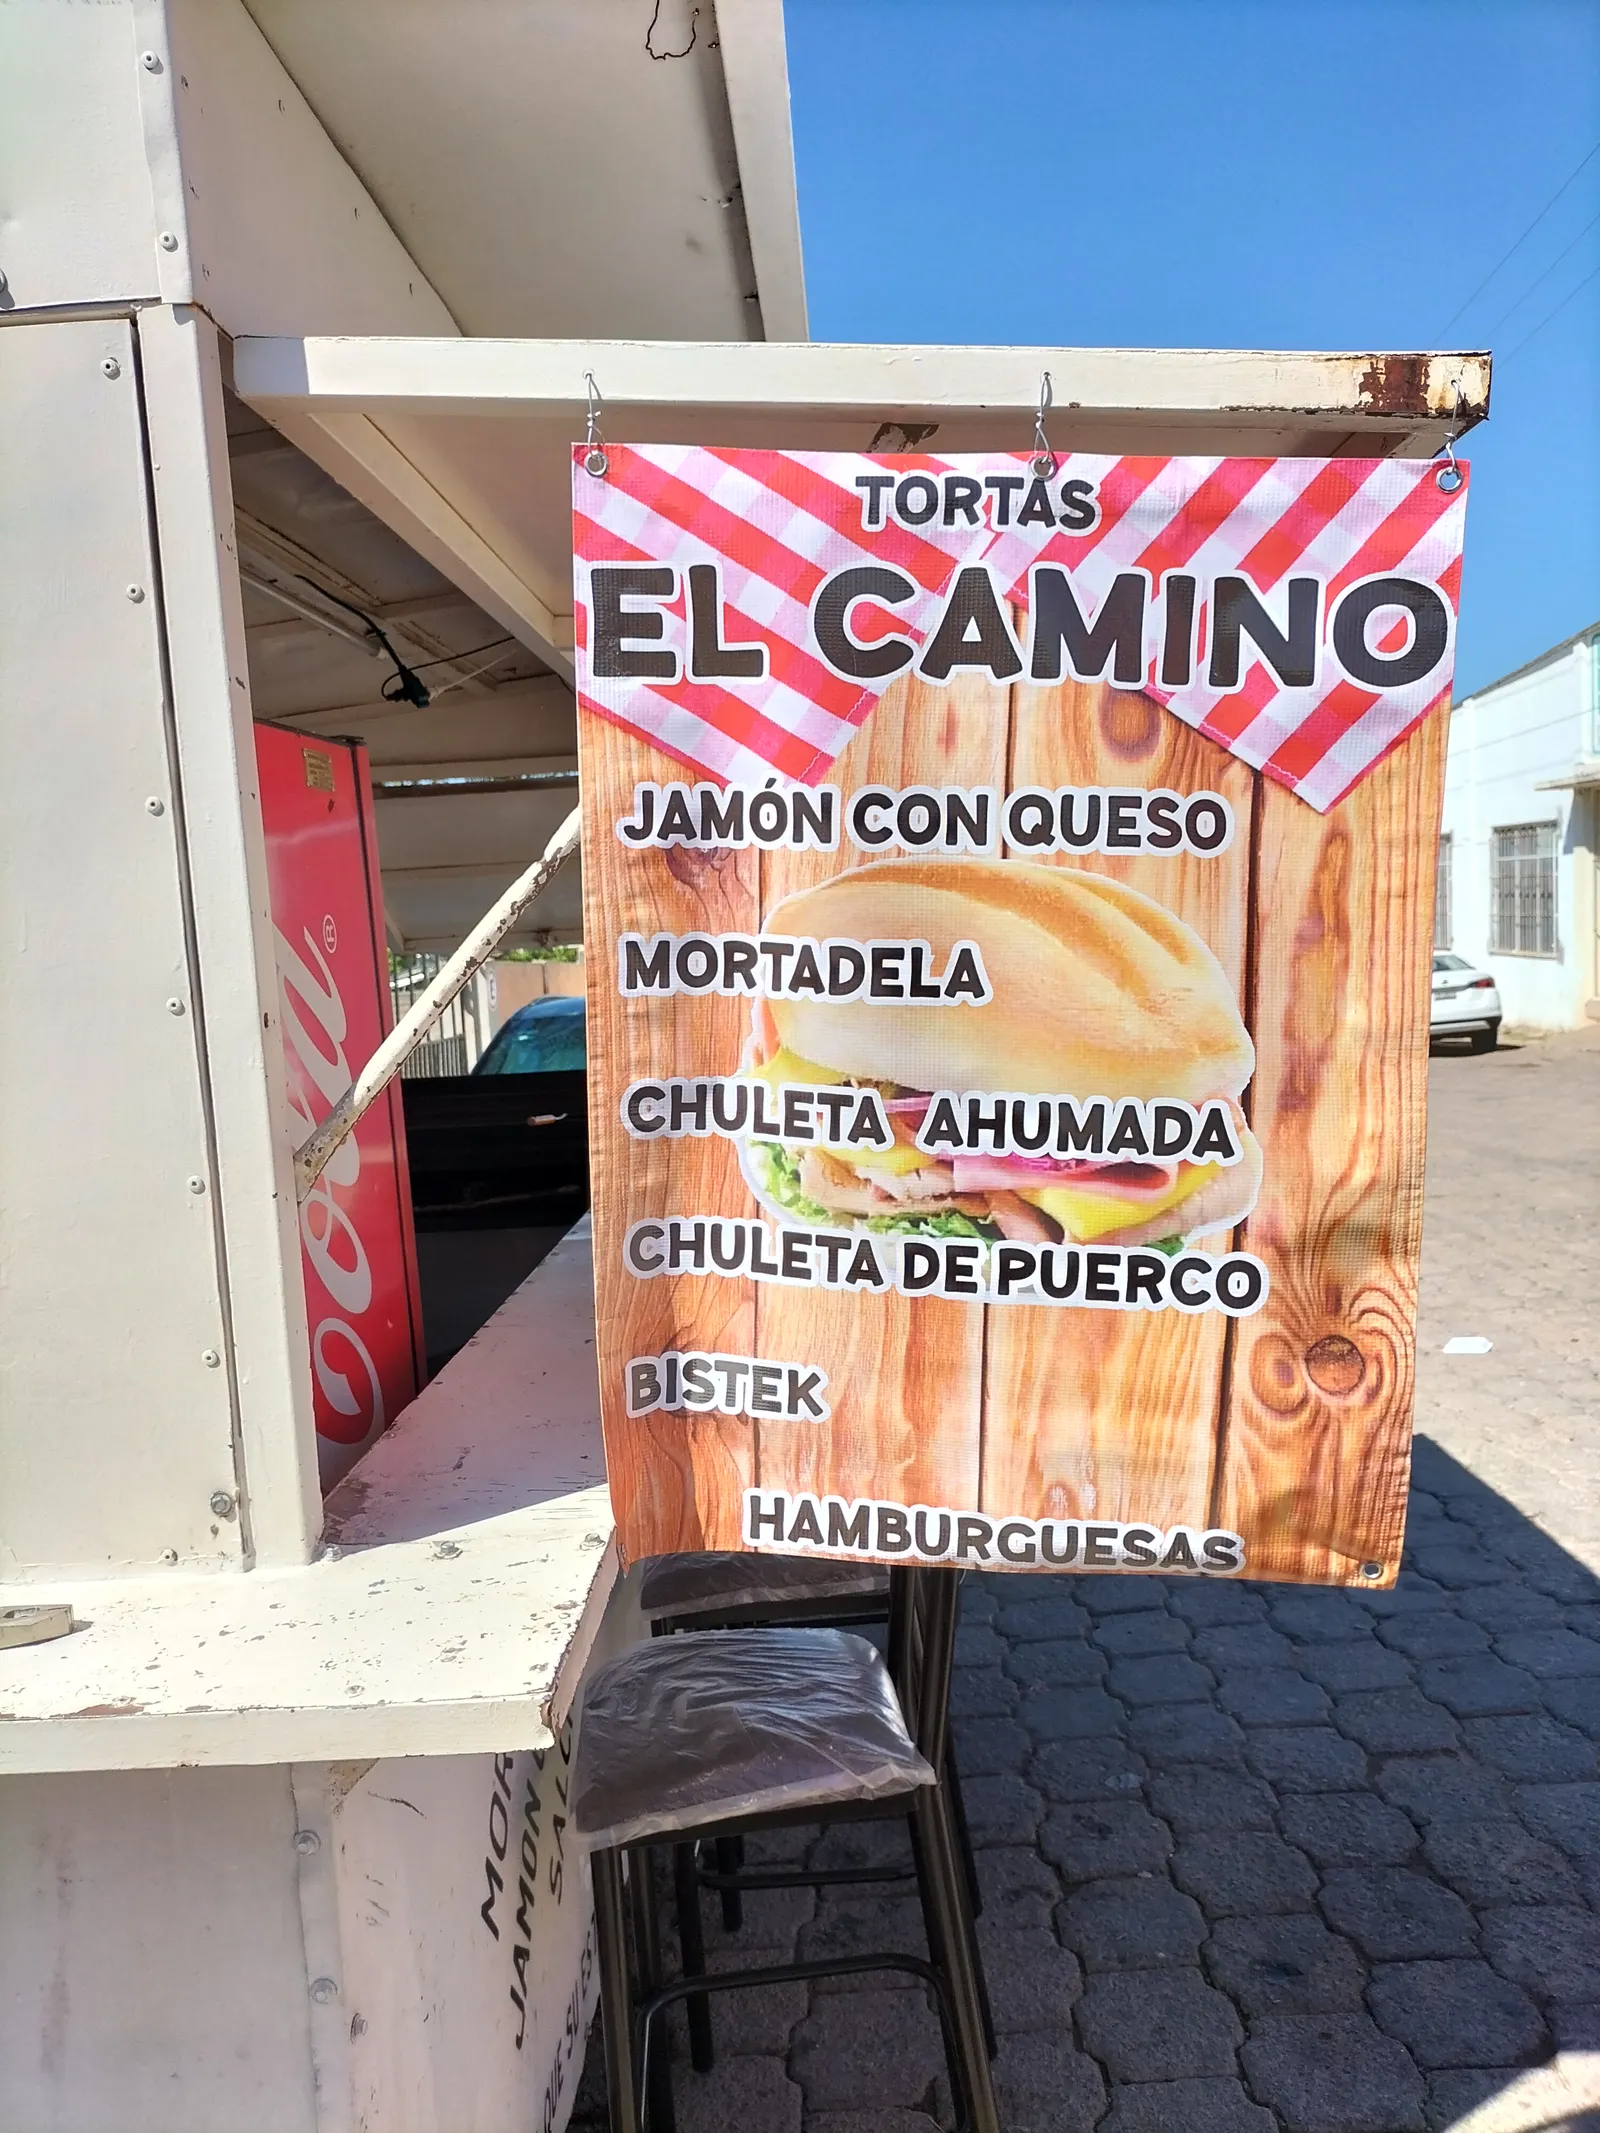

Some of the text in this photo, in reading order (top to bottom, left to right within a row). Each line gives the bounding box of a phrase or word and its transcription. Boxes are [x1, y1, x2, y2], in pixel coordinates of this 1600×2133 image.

[855, 475, 1096, 530] TORTAS
[590, 564, 1448, 688] EL CAMINO
[623, 777, 1227, 850] JAMÓN CON QUESO
[625, 939, 986, 999] MORTADELA
[627, 1083, 1236, 1158] CHULETA AHUMADA
[629, 1222, 1262, 1310] CHULETA DE PUERCO
[631, 1358, 824, 1417] BISTEK
[750, 1495, 1239, 1571] HAMBURGUESAS
[510, 1777, 541, 2050] JAMON
